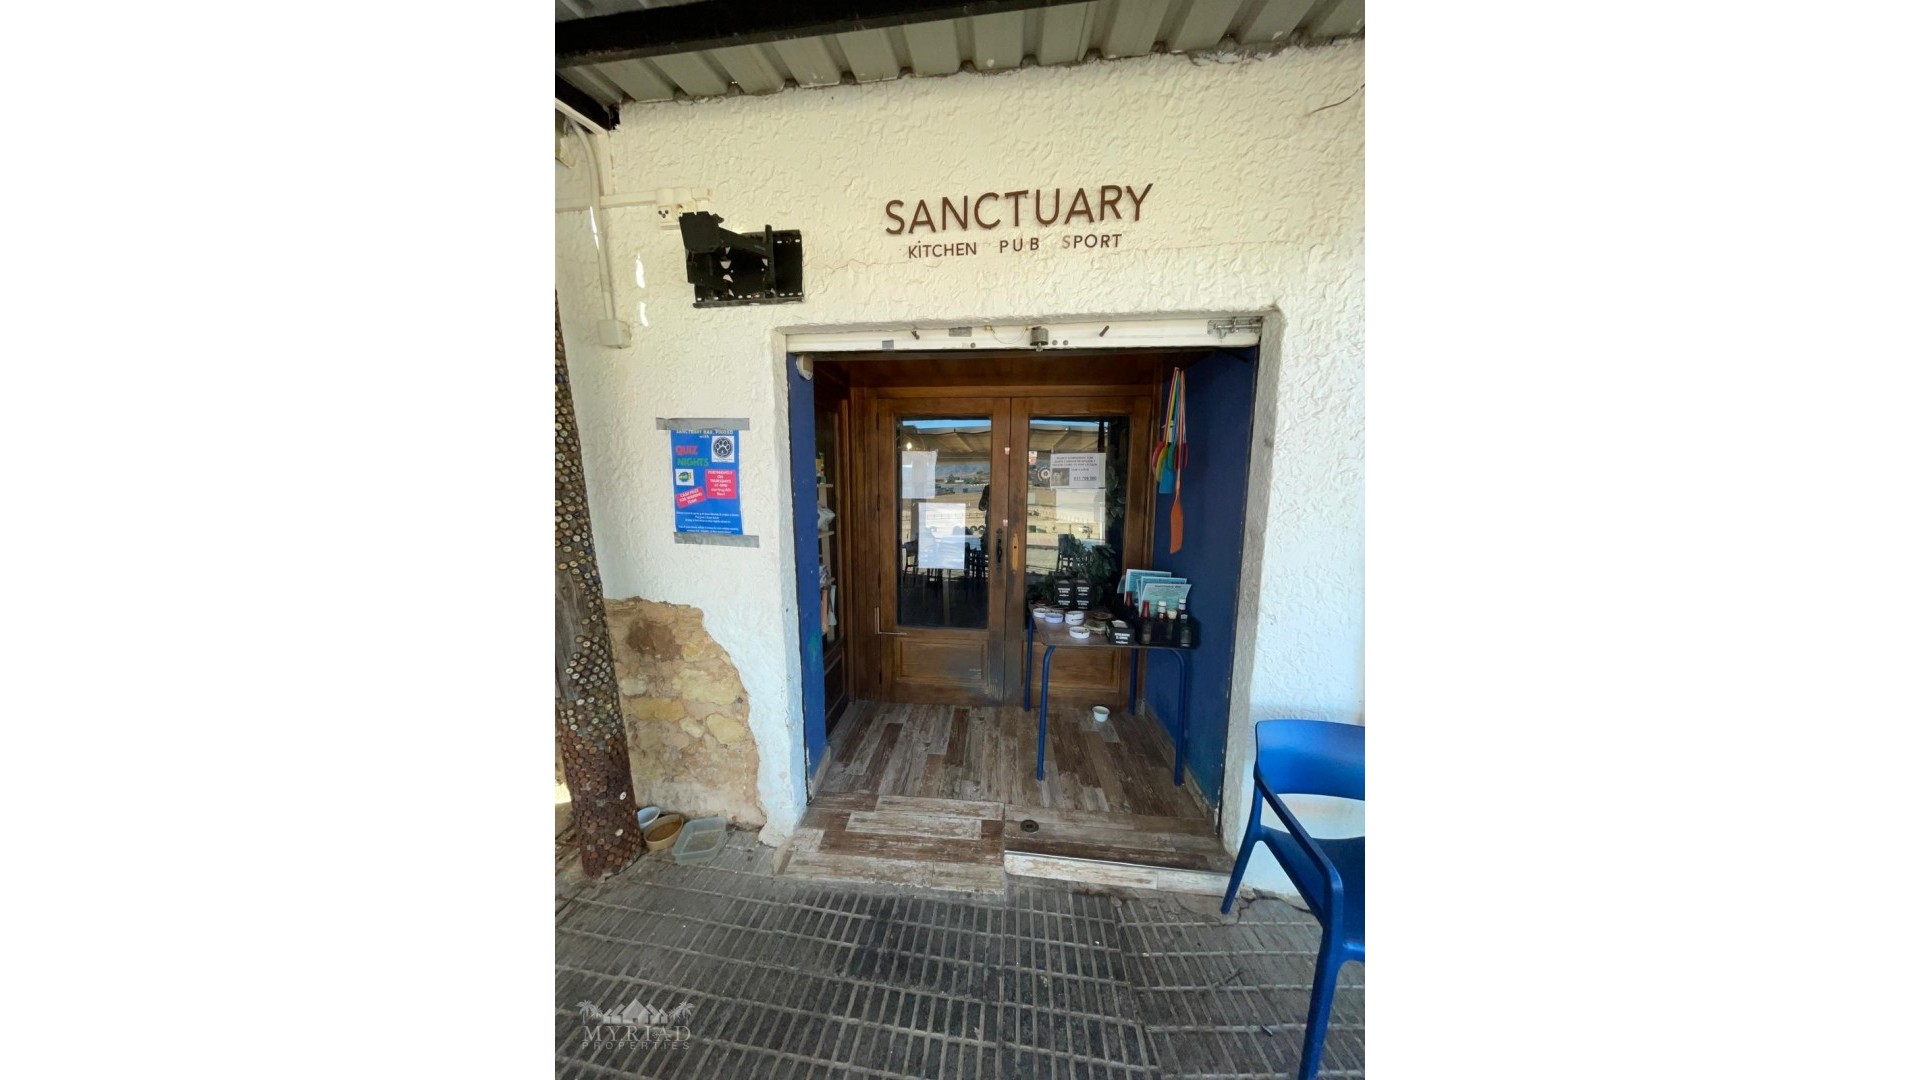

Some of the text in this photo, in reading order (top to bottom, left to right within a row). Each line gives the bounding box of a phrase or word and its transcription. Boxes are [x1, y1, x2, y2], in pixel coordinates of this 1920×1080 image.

[885, 183, 1153, 235] SANCTUARY
[1000, 237, 1039, 253] PUB
[1062, 233, 1122, 249] SPORT
[676, 445, 698, 456] QUIZ
[677, 457, 709, 466] NIGHTS
